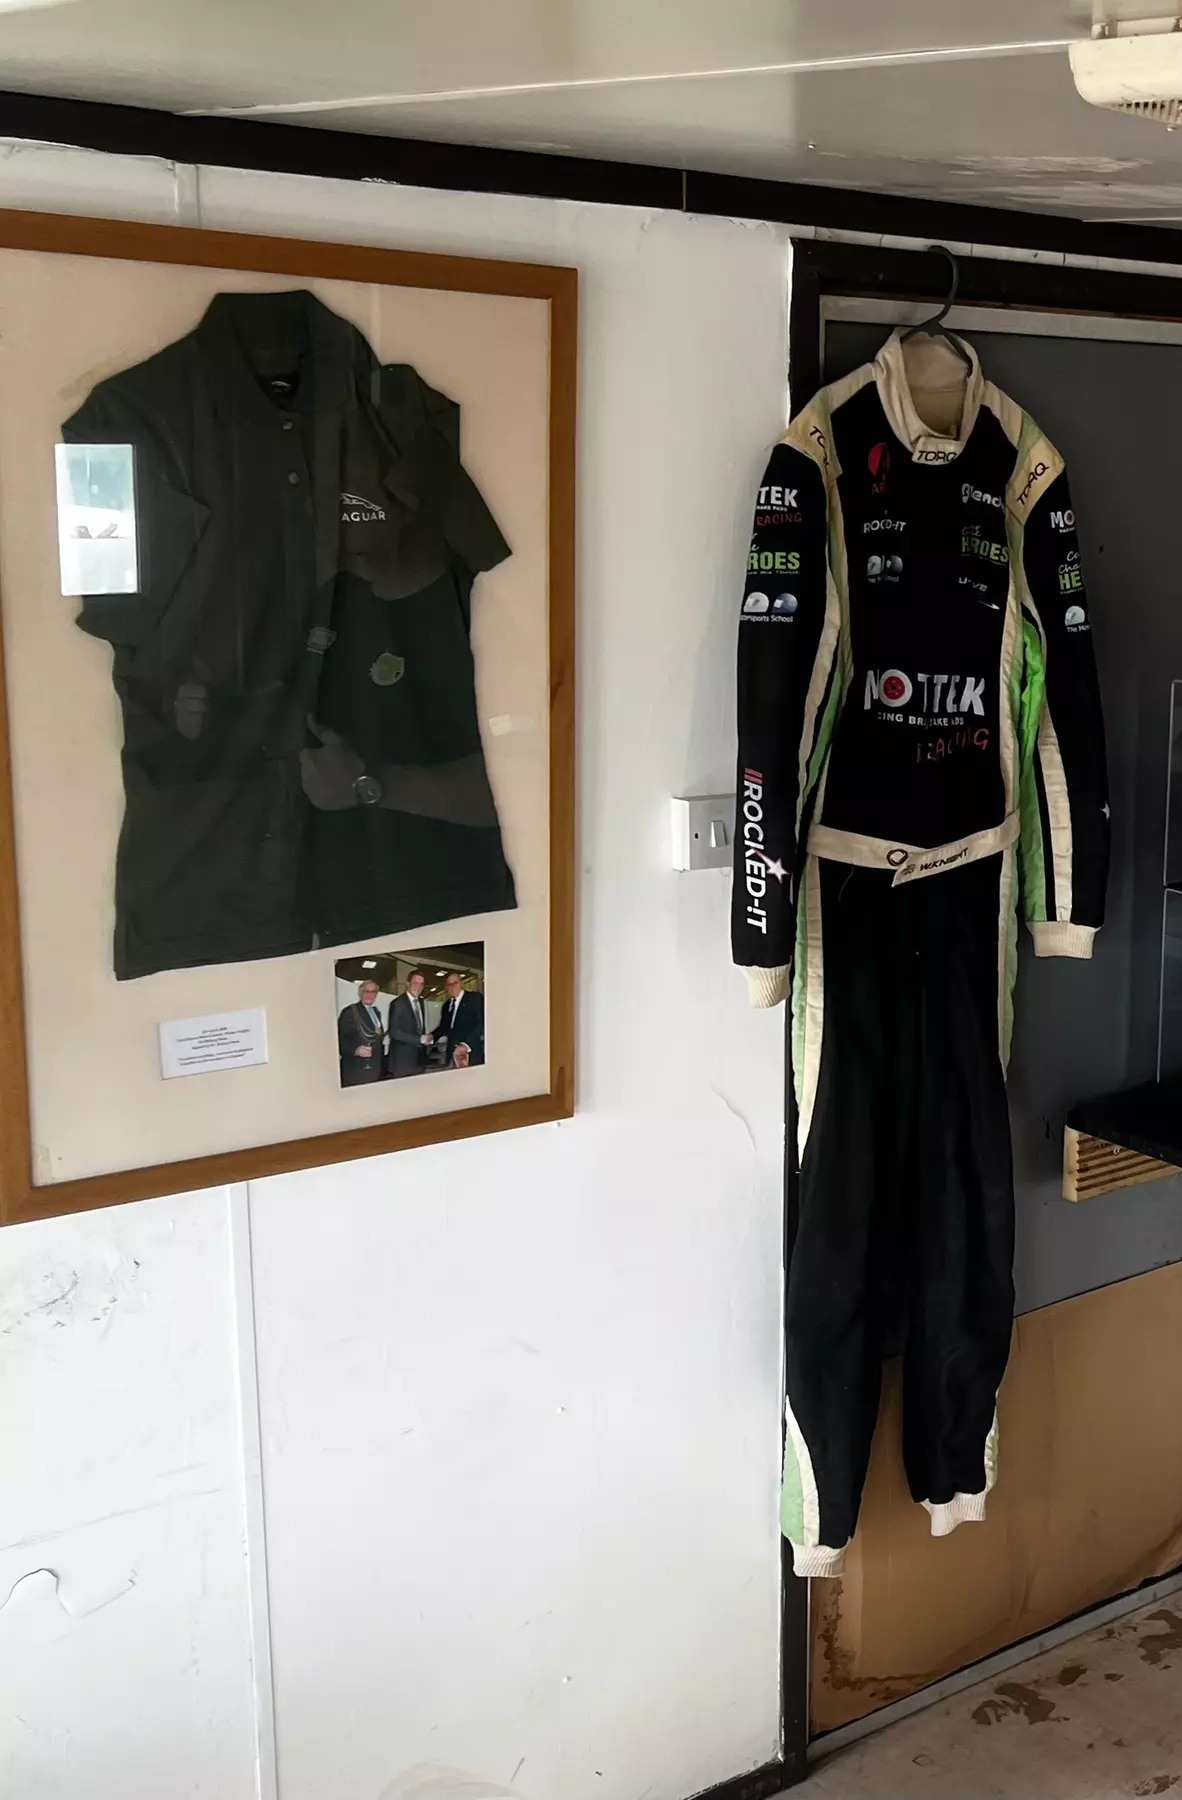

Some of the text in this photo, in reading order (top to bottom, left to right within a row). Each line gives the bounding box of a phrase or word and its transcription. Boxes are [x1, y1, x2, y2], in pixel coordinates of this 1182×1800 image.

[759, 486, 798, 508] TEK
[341, 510, 387, 522] AGUAR
[748, 552, 800, 570] ROES
[1059, 570, 1082, 590] HE
